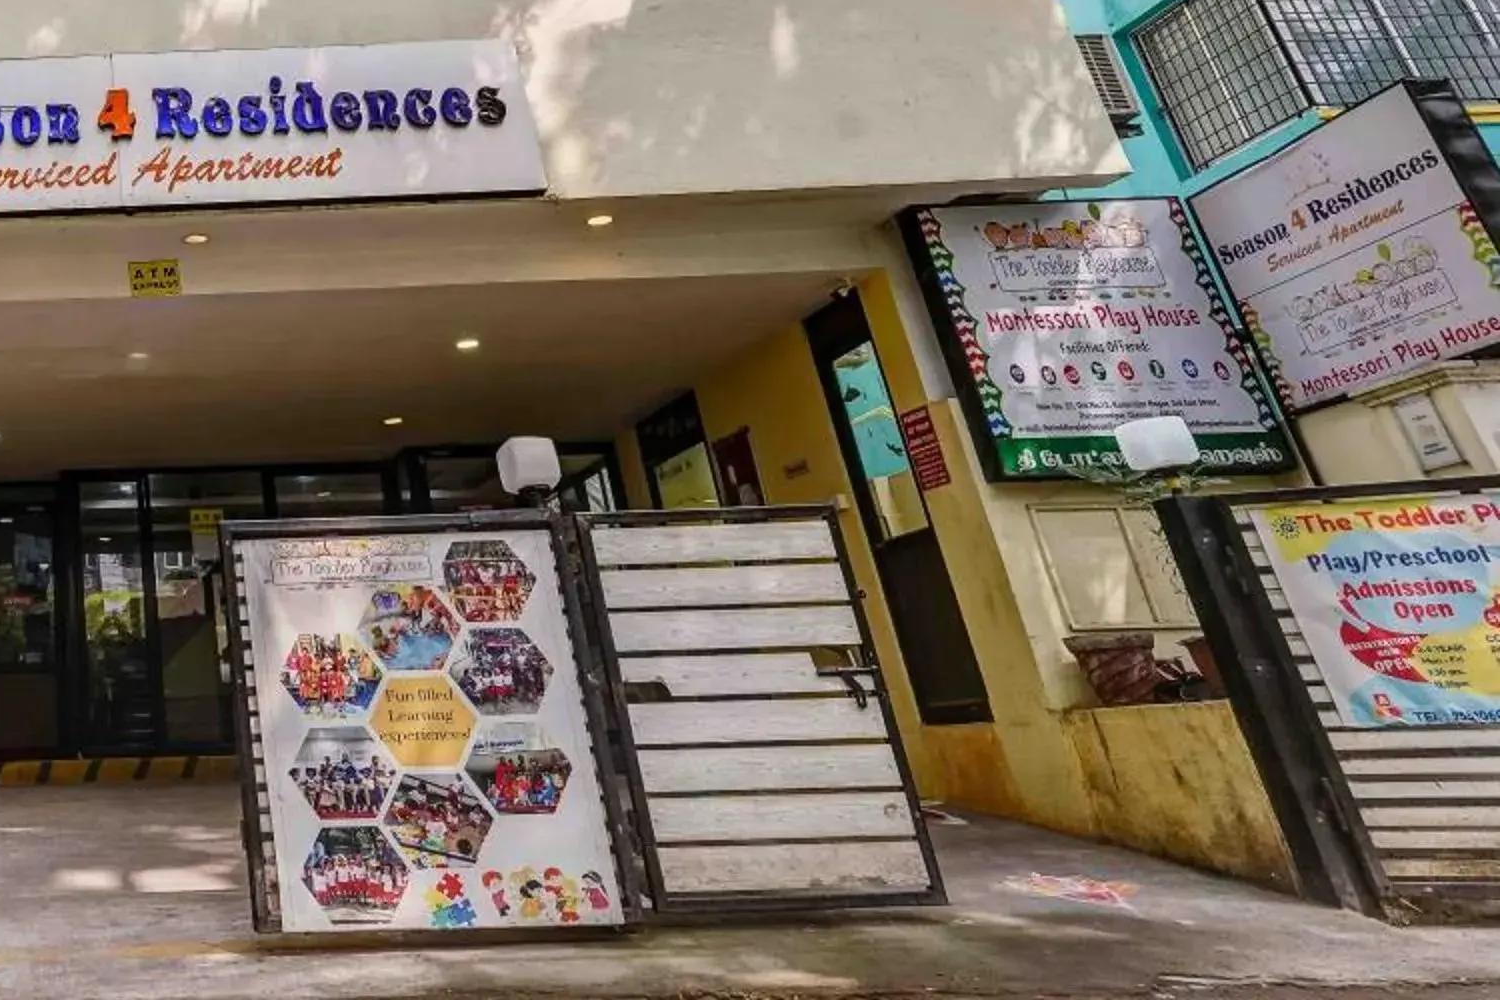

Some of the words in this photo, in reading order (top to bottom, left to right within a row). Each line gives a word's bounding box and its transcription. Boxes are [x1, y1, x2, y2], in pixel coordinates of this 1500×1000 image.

[97, 88, 137, 142] 4
[152, 76, 507, 138] Residences
[132, 147, 344, 192] Apartment
[1218, 222, 1290, 264] Season
[1291, 209, 1308, 230] 4
[1306, 148, 1439, 223] Residences
[1267, 236, 1323, 272] Serviced
[1329, 200, 1405, 244] Apartment
[985, 306, 1089, 332] Montessori
[1092, 304, 1140, 334] Play
[1144, 306, 1201, 328] House
[1300, 350, 1391, 396] Montessori
[1393, 338, 1440, 361] Play
[1440, 314, 1500, 348] House
[1296, 514, 1352, 533] The
[1355, 506, 1467, 529] Toddler
[1306, 544, 1491, 574] Play/Preschool
[1341, 577, 1477, 601] Admissions
[1394, 600, 1454, 623] Open
[385, 690, 414, 702] Fun
[418, 688, 453, 700] filled
[388, 709, 454, 724] Learning
